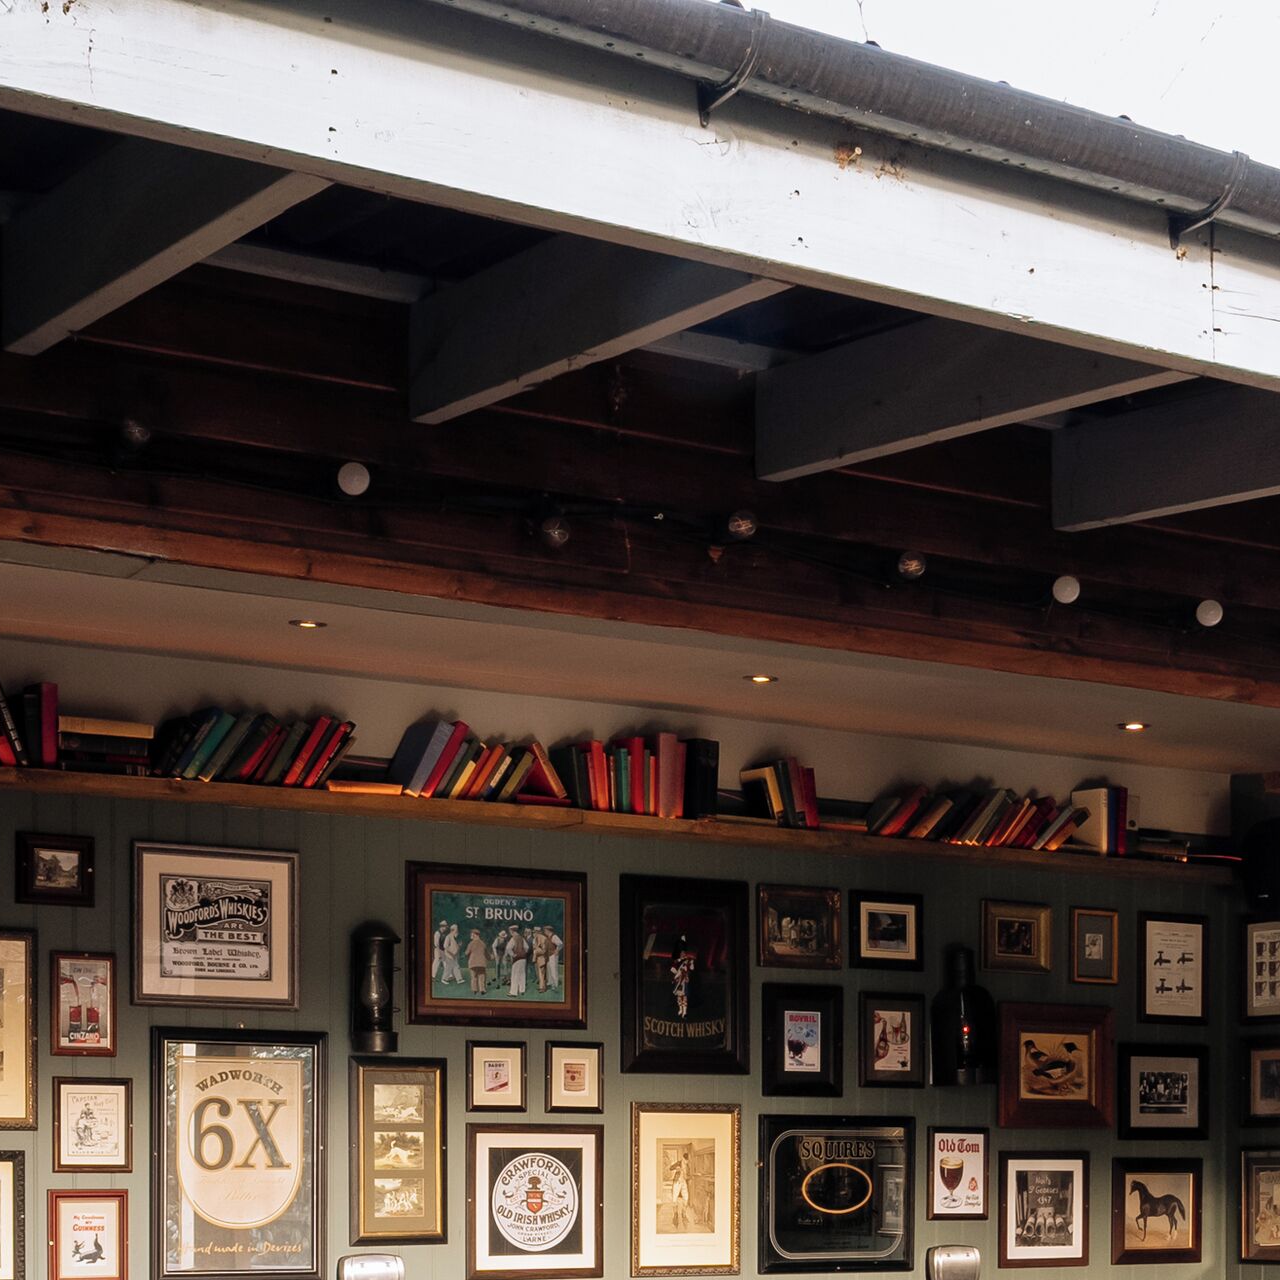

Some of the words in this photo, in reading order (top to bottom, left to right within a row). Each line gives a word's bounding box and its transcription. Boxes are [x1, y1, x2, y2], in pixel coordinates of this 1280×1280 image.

[483, 898, 517, 906] OGDEN'S
[167, 901, 220, 934] WOODFORD'S
[219, 899, 264, 922] WHISKIES
[484, 907, 535, 922] BRUNO
[203, 931, 224, 940] THE
[228, 932, 258, 941] BEST
[789, 1015, 817, 1023] BOVRIL
[644, 1016, 684, 1038] SCOTCH
[685, 1017, 726, 1038] WHISKY
[69, 1032, 100, 1041] CINZANO
[195, 1069, 284, 1096] WADWORTH
[187, 1095, 292, 1171] 6X
[800, 1140, 876, 1160] SQUIRES
[938, 1138, 956, 1153] Old
[957, 1138, 980, 1153] Tom
[501, 1158, 568, 1186] CRAWFORD'S
[518, 1170, 549, 1181] SPECIAL
[497, 1204, 513, 1219] OLD
[513, 1212, 539, 1225] IRISH
[73, 1224, 105, 1232] GUINNESS
